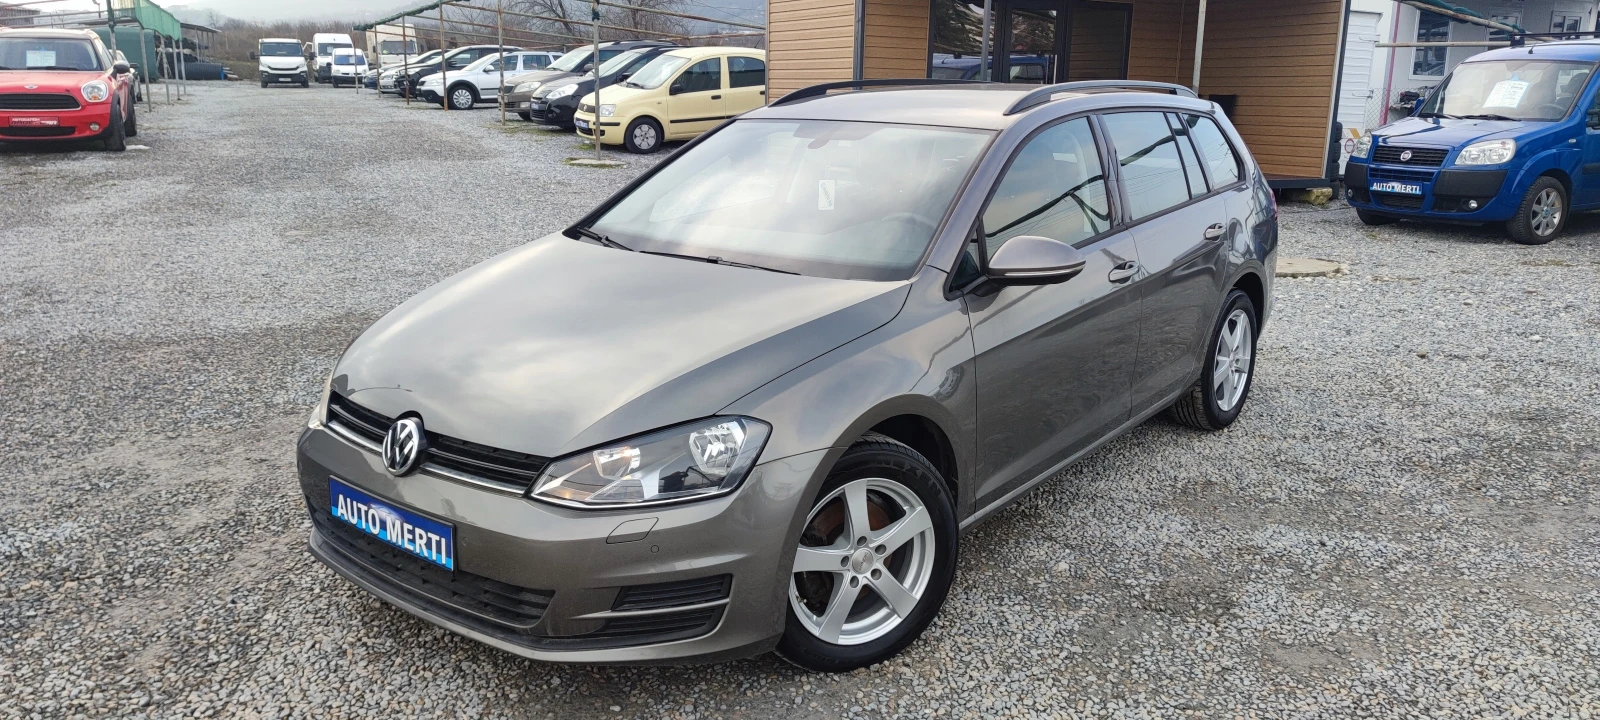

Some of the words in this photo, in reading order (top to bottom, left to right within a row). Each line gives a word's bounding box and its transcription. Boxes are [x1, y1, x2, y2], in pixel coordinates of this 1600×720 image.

[1372, 182, 1392, 191] AUTO
[1395, 184, 1420, 194] MERTI
[337, 494, 380, 535] AUTO
[385, 515, 447, 565] MERTI
